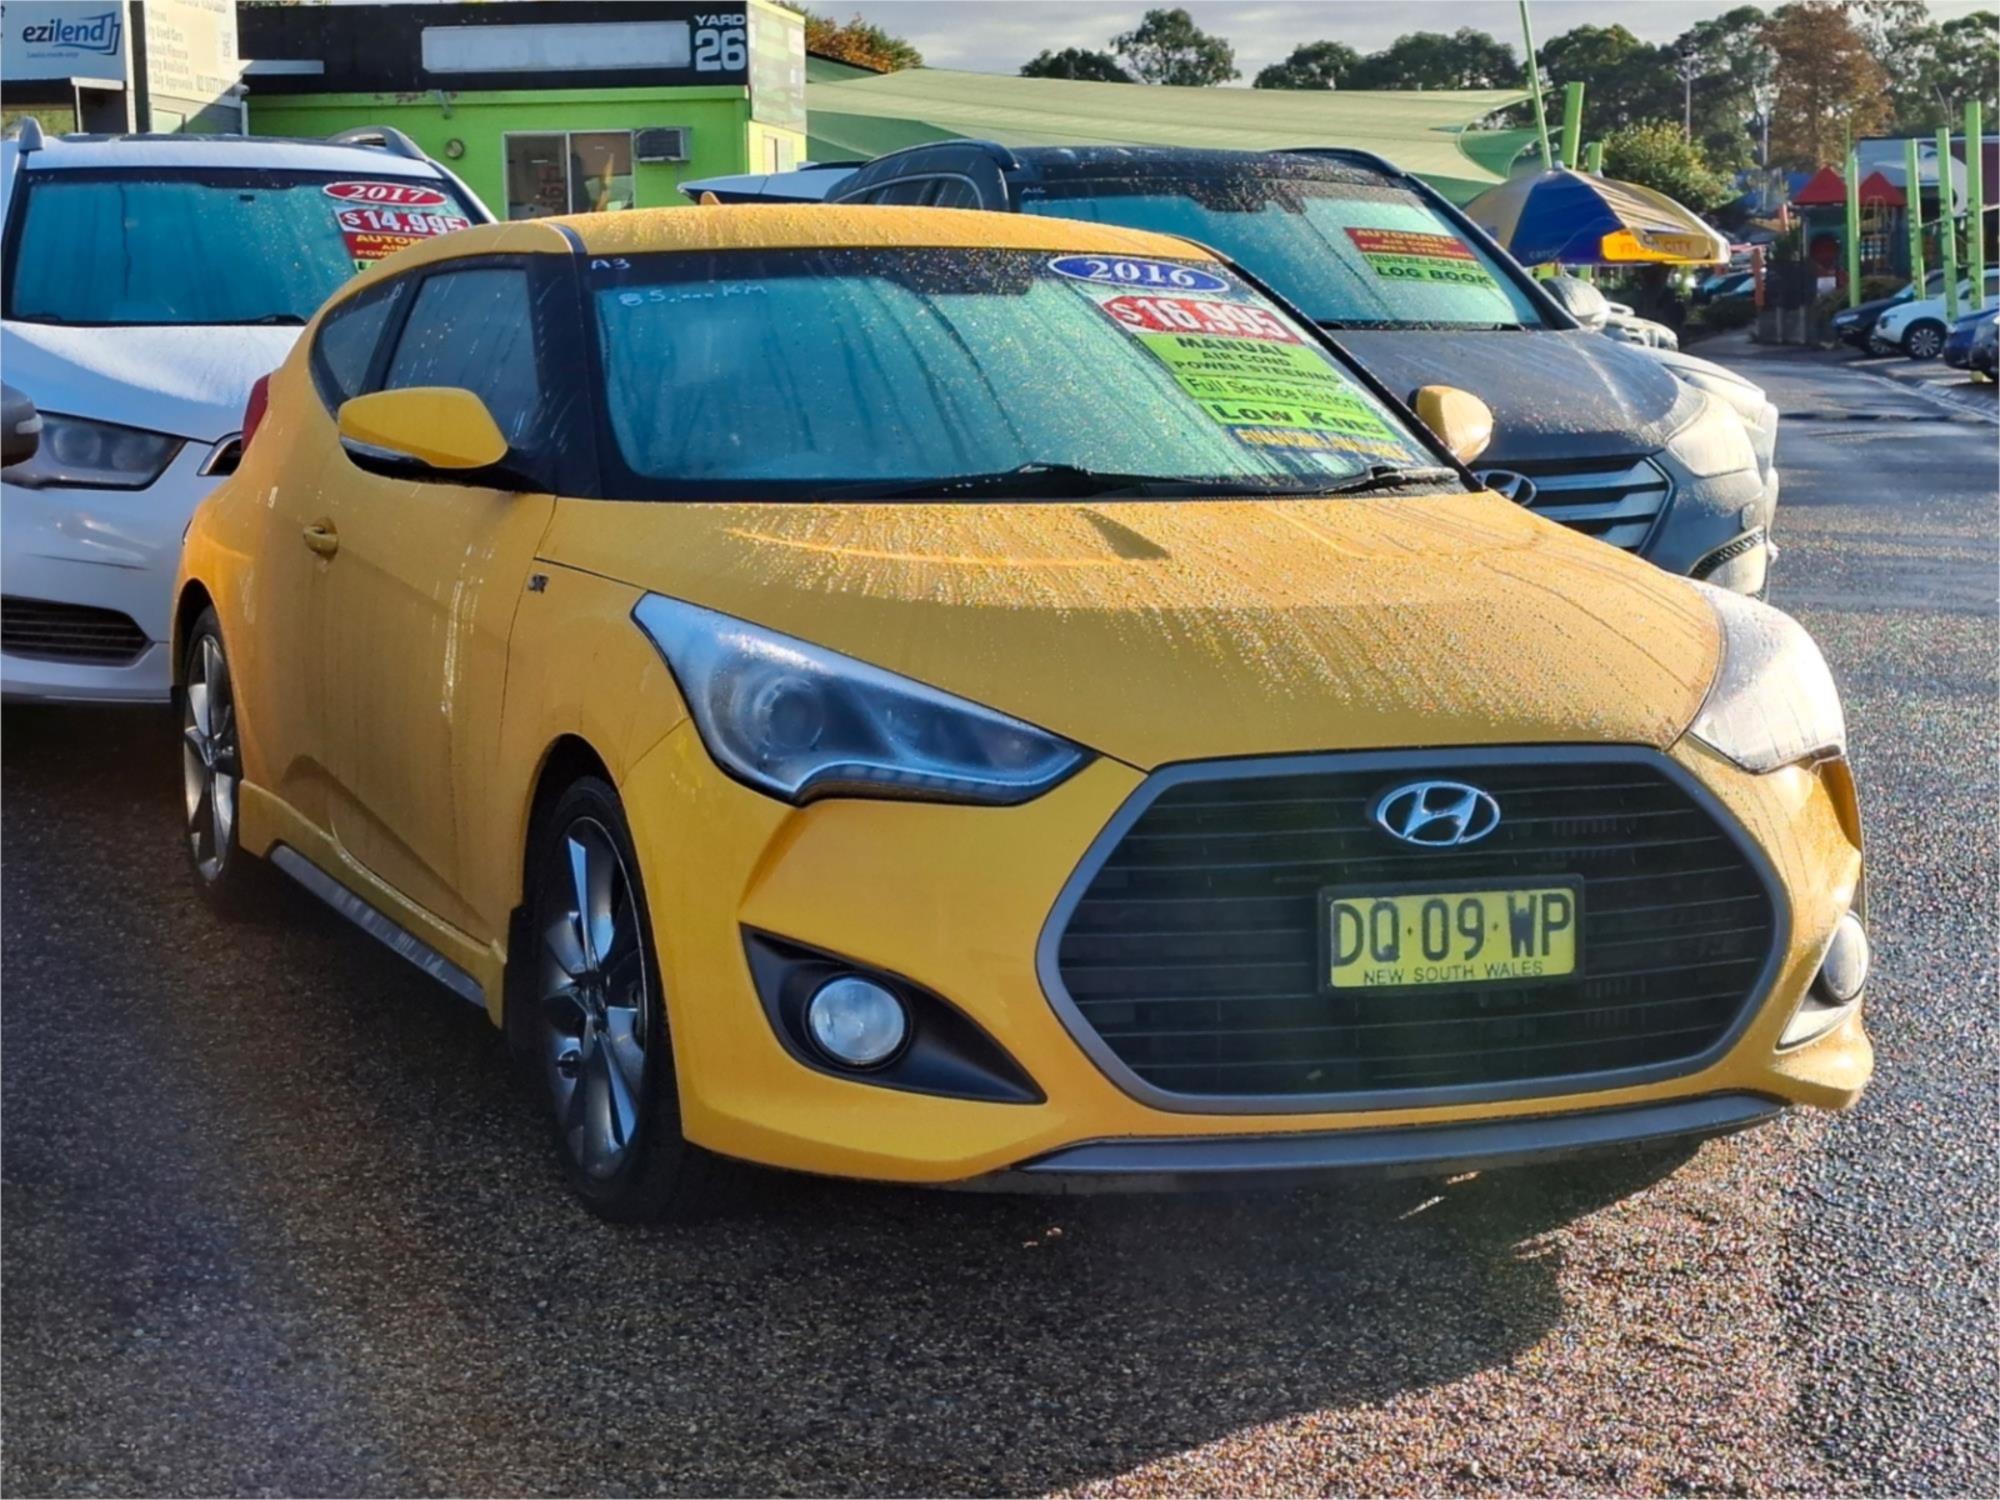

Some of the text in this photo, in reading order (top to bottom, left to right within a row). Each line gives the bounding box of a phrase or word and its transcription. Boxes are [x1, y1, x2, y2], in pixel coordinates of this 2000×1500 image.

[23, 15, 106, 43] ezilend
[694, 14, 746, 27] YARD
[695, 28, 746, 72] 26
[347, 185, 426, 201] 2017
[590, 258, 631, 270] A3
[1085, 260, 1196, 286] 2016
[1376, 266, 1492, 285] LOG BOOK
[1175, 337, 1291, 358] MANUAL
[1201, 351, 1234, 362] AIR
[1172, 360, 1341, 383] POWER STEERING
[1185, 377, 1226, 394] Full
[1226, 380, 1299, 402] Service
[1210, 403, 1294, 423] Low
[1333, 892, 1572, 967] DQ 09 WP
[1363, 960, 1543, 986] NEW SOUTH WALES
